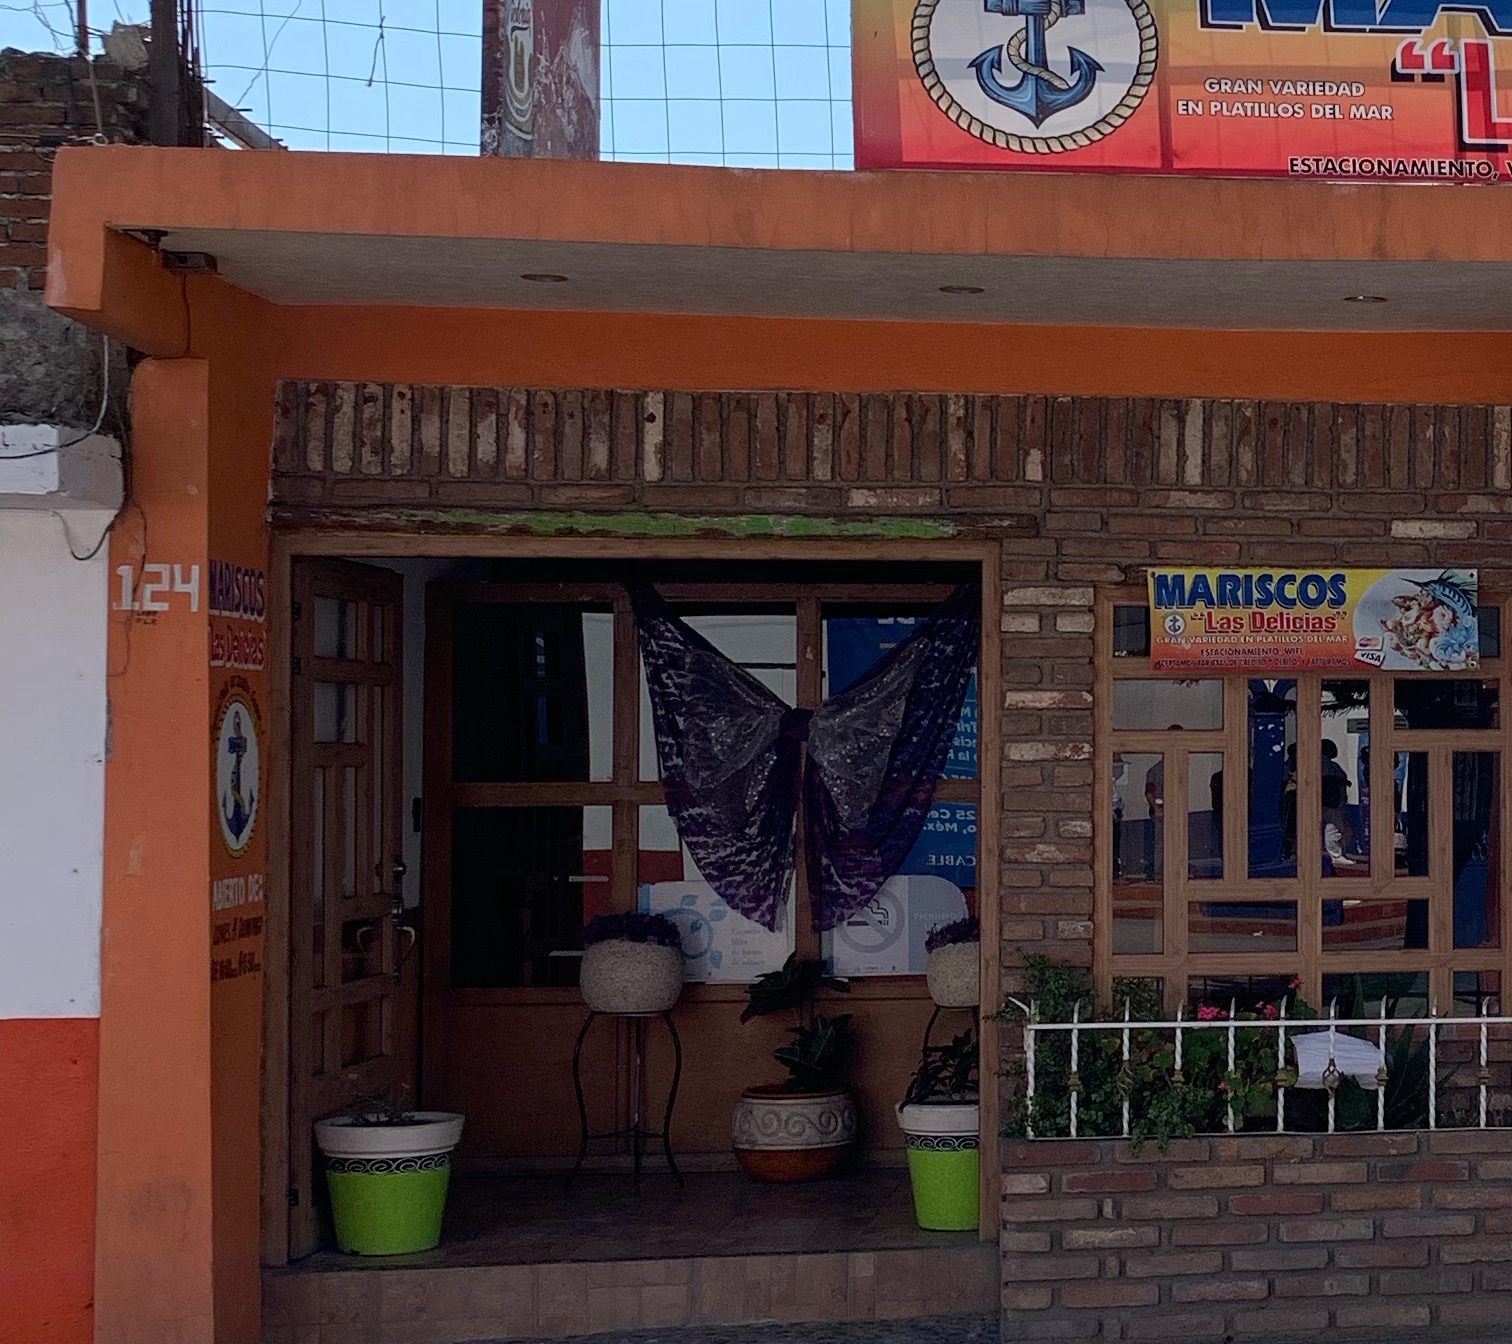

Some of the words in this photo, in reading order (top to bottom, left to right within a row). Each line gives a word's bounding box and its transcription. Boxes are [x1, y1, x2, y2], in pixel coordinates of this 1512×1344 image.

[1204, 77, 1263, 95] GRAN
[1269, 80, 1365, 97] VARIEDAD
[1177, 100, 1204, 116] EN
[1210, 101, 1305, 118] PLATILLOS
[1311, 103, 1343, 119] DEL
[1349, 104, 1394, 120] MAR
[1288, 157, 1499, 181] ESTACIONAMIENTO,
[112, 563, 200, 613] 124
[1155, 573, 1347, 609] MARISCOS
[1156, 636, 1186, 644] GRAN
[1189, 636, 1238, 644] VARIEDAD
[1240, 636, 1254, 644] EN
[1257, 636, 1303, 644] PLATILLOS
[1307, 636, 1324, 644] DEL
[1326, 636, 1349, 644] MAR
[1361, 652, 1381, 663] VISA
